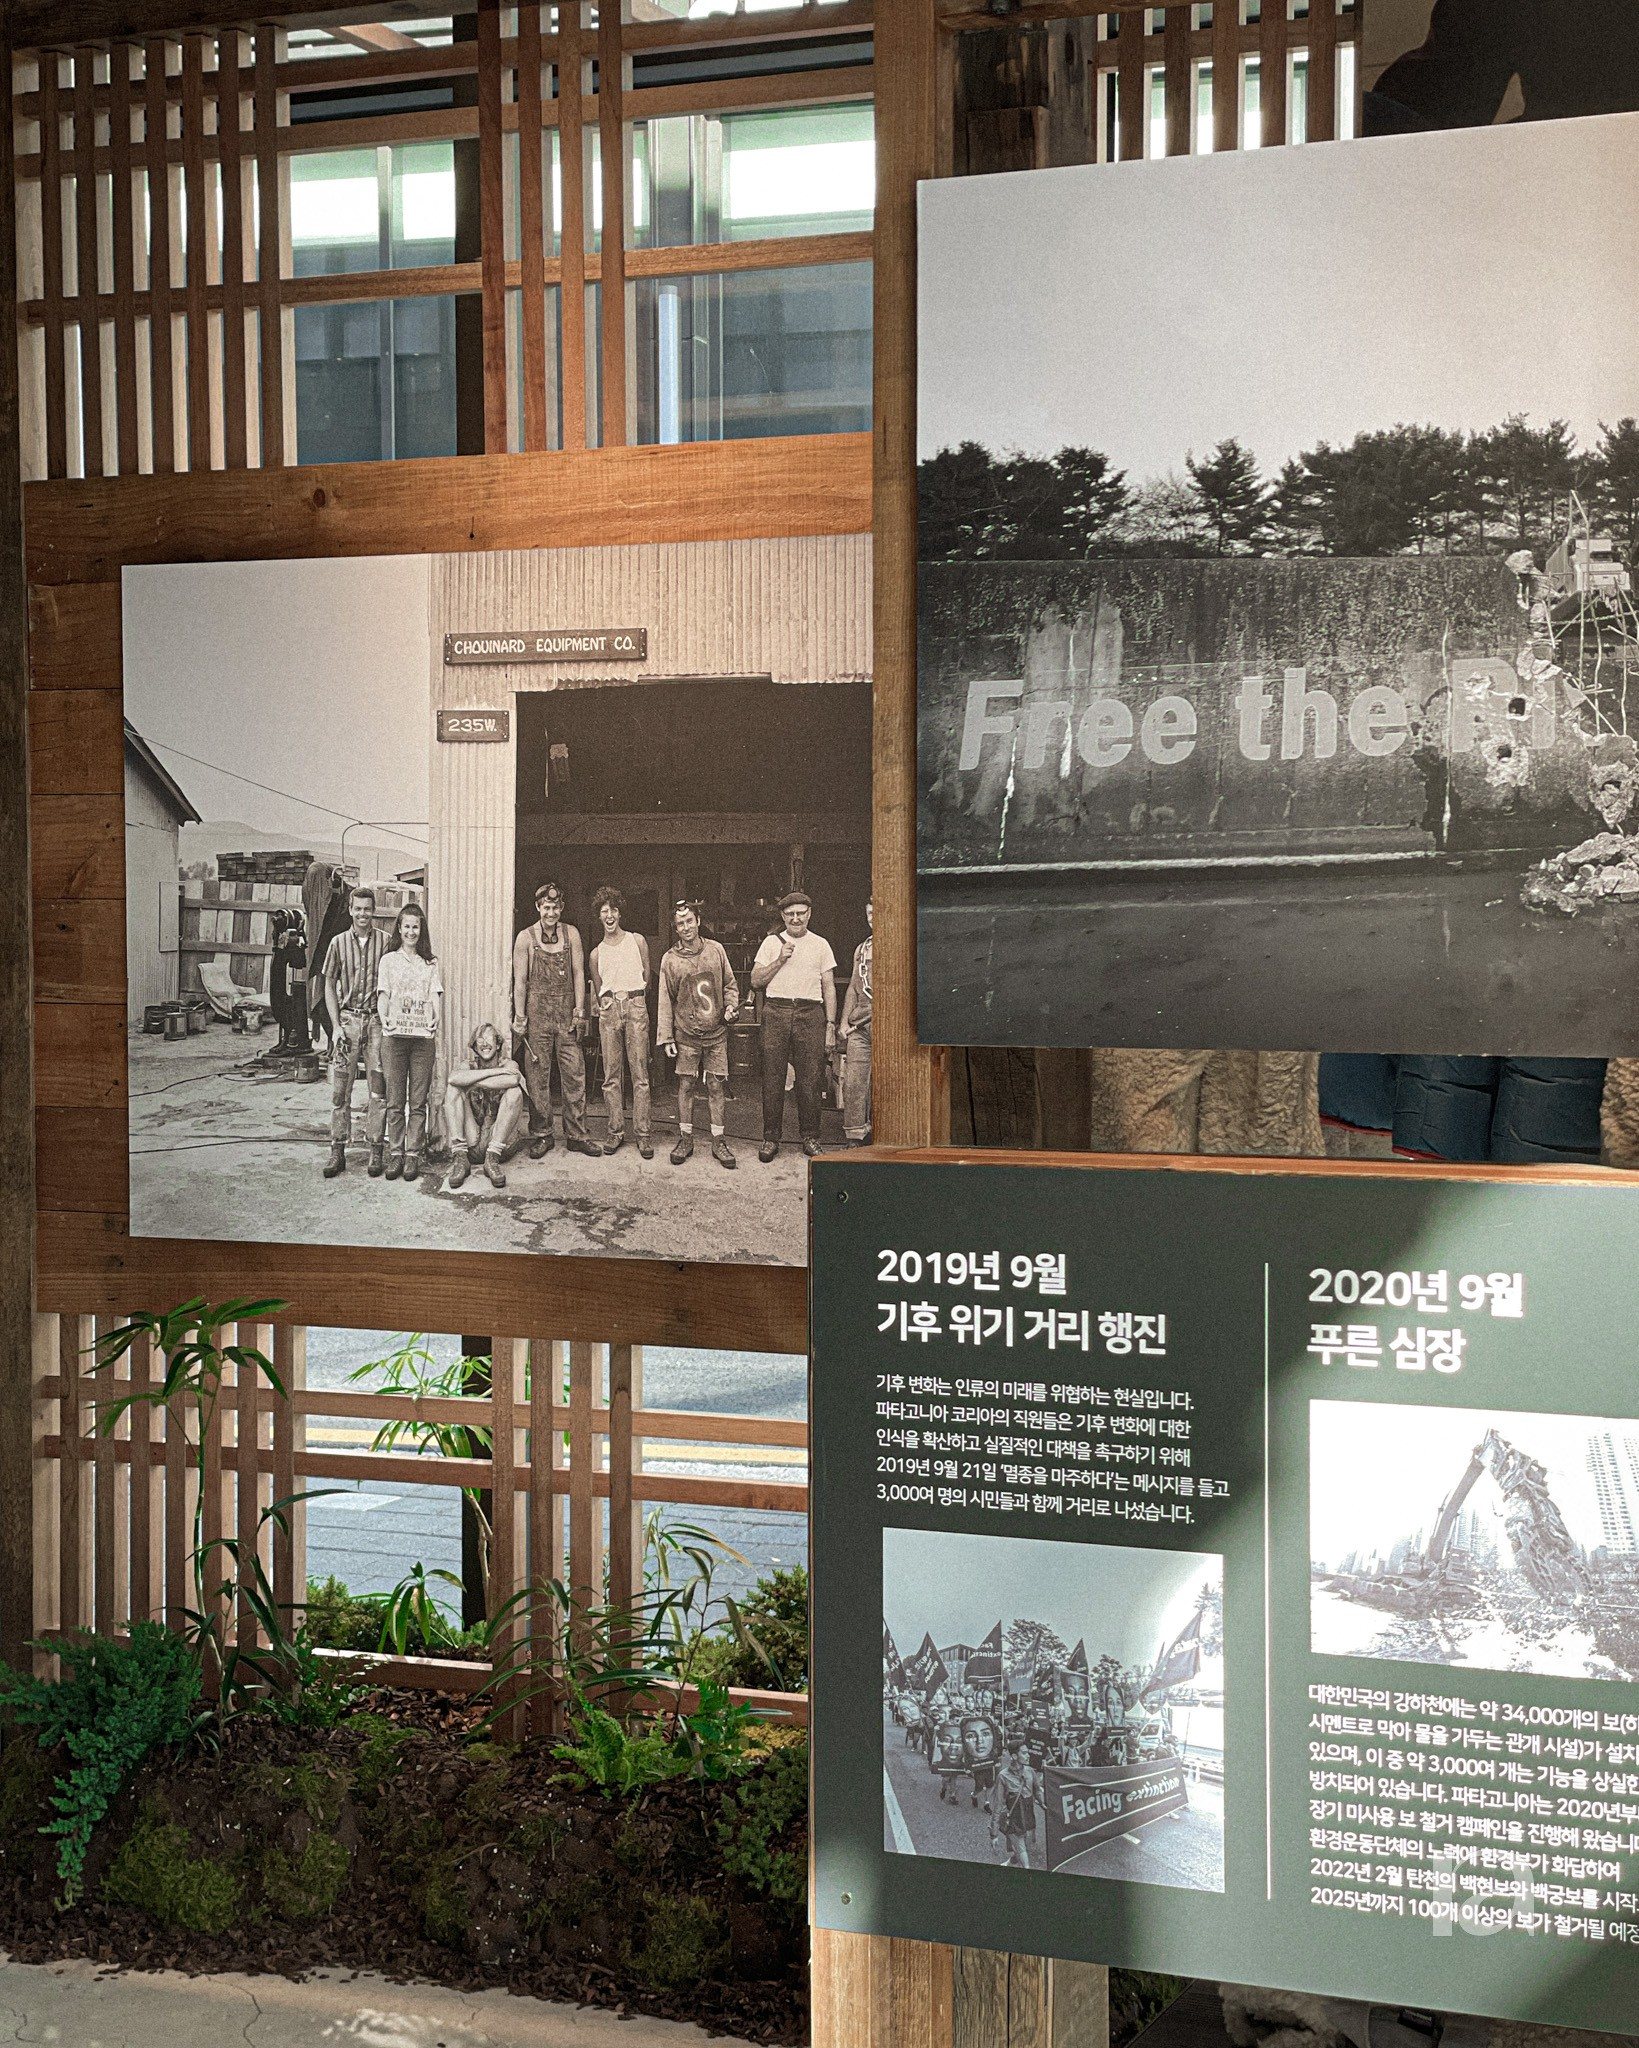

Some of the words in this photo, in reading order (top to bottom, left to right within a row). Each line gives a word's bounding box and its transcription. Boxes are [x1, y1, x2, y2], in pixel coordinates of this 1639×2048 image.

[453, 638, 526, 655] CHOUINARD
[536, 636, 607, 654] EQUIPMENT
[614, 635, 636, 651] CO.
[959, 679, 1198, 771] Free
[1235, 668, 1408, 761] the
[878, 1250, 999, 1290] 2019년
[1011, 1254, 1066, 1295] 9월
[1309, 1267, 1448, 1313] 2020년
[1458, 1272, 1524, 1318] 9월
[878, 1301, 942, 1342] 기후
[949, 1305, 1013, 1347] 위기
[1024, 1309, 1088, 1351] 거리
[1098, 1312, 1166, 1355] 행진
[1307, 1323, 1383, 1367] 푸른
[1388, 1326, 1467, 1374] 심장
[877, 1374, 905, 1392] 기후
[909, 1376, 952, 1395] 변화는
[956, 1379, 998, 1398] 인류의
[1003, 1382, 1047, 1401] 미래를
[1051, 1385, 1111, 1405] 위협하는
[1114, 1388, 1194, 1410] 현실입니다.
[876, 1401, 949, 1423] 파타고니아
[951, 1407, 1009, 1427] 코리아의
[1014, 1410, 1073, 1431] 직원들은
[1077, 1414, 1107, 1433] 기후
[1111, 1417, 1155, 1436] 변화에
[1160, 1420, 1191, 1438] 대한
[877, 1429, 920, 1448] 인식을
[923, 1431, 981, 1451] 확산하고
[984, 1436, 1042, 1456] 실질적인
[1047, 1440, 1092, 1460] 대책을
[1095, 1443, 1154, 1465] 촉구하기
[1159, 1448, 1190, 1467] 위해
[877, 1457, 929, 1476] 2019년
[934, 1460, 958, 1478] 9월
[963, 1463, 996, 1481] 21일
[1133, 1474, 1194, 1496] 메시지를
[1198, 1479, 1230, 1497] 들고
[877, 1484, 933, 1504] 3,000여
[938, 1488, 966, 1506] 명의
[970, 1490, 1030, 1511] 시민들과
[1032, 1494, 1062, 1514] 함께
[1066, 1497, 1111, 1516] 거리로
[1115, 1501, 1194, 1524] 나섰습니다.
[1309, 1685, 1389, 1710] 대한민국의
[1394, 1693, 1477, 1718] 강하천에는
[1480, 1701, 1498, 1721] 약
[1502, 1704, 1597, 1731] 34,000개의
[1309, 1713, 1374, 1735] 시멘트로
[1378, 1720, 1411, 1741] 막아
[1414, 1724, 1448, 1745] 물을
[1452, 1728, 1502, 1750] 가두는
[1506, 1733, 1540, 1755] 관개
[1544, 1737, 1602, 1761] 시설)가
[1310, 1742, 1362, 1766] 있으며,
[1366, 1748, 1382, 1767] 이
[1386, 1750, 1404, 1770] 중
[1407, 1752, 1425, 1772] 약
[1429, 1755, 1494, 1780] 3,000여
[1499, 1762, 1534, 1783] 개는
[1538, 1766, 1589, 1789] 기능을
[1061, 1789, 1123, 1824] Facing
[1126, 1776, 1179, 1802] extinction
[1310, 1771, 1373, 1796] 방치되어
[1378, 1778, 1448, 1803] 있습니다.
[1452, 1787, 1553, 1815] 파타고니아는
[1557, 1798, 1639, 1824] 2020년부
[1310, 1800, 1341, 1821] 장기
[1347, 1804, 1396, 1827] 미사용
[1398, 1810, 1416, 1827] 보
[1420, 1811, 1452, 1834] 철거
[1457, 1816, 1524, 1842] 캠페인을
[1528, 1824, 1578, 1848] 진행해
[1310, 1828, 1422, 1859] 환경운동단체의
[1481, 1847, 1549, 1874] 환경부가
[1552, 1855, 1620, 1882] 화답하여
[1311, 1858, 1370, 1882] 2022년
[1376, 1866, 1402, 1886] 2월
[1407, 1869, 1455, 1893] 탄천의
[1531, 1883, 1599, 1909] 백궁보를
[1603, 1892, 1639, 1913] 시작
[1311, 1887, 1403, 1915] 2025년까지
[1409, 1899, 1458, 1922] 100개
[1462, 1905, 1512, 1929] 이상의
[1516, 1911, 1551, 1933] 보가
[1554, 1915, 1604, 1939] 철거될
